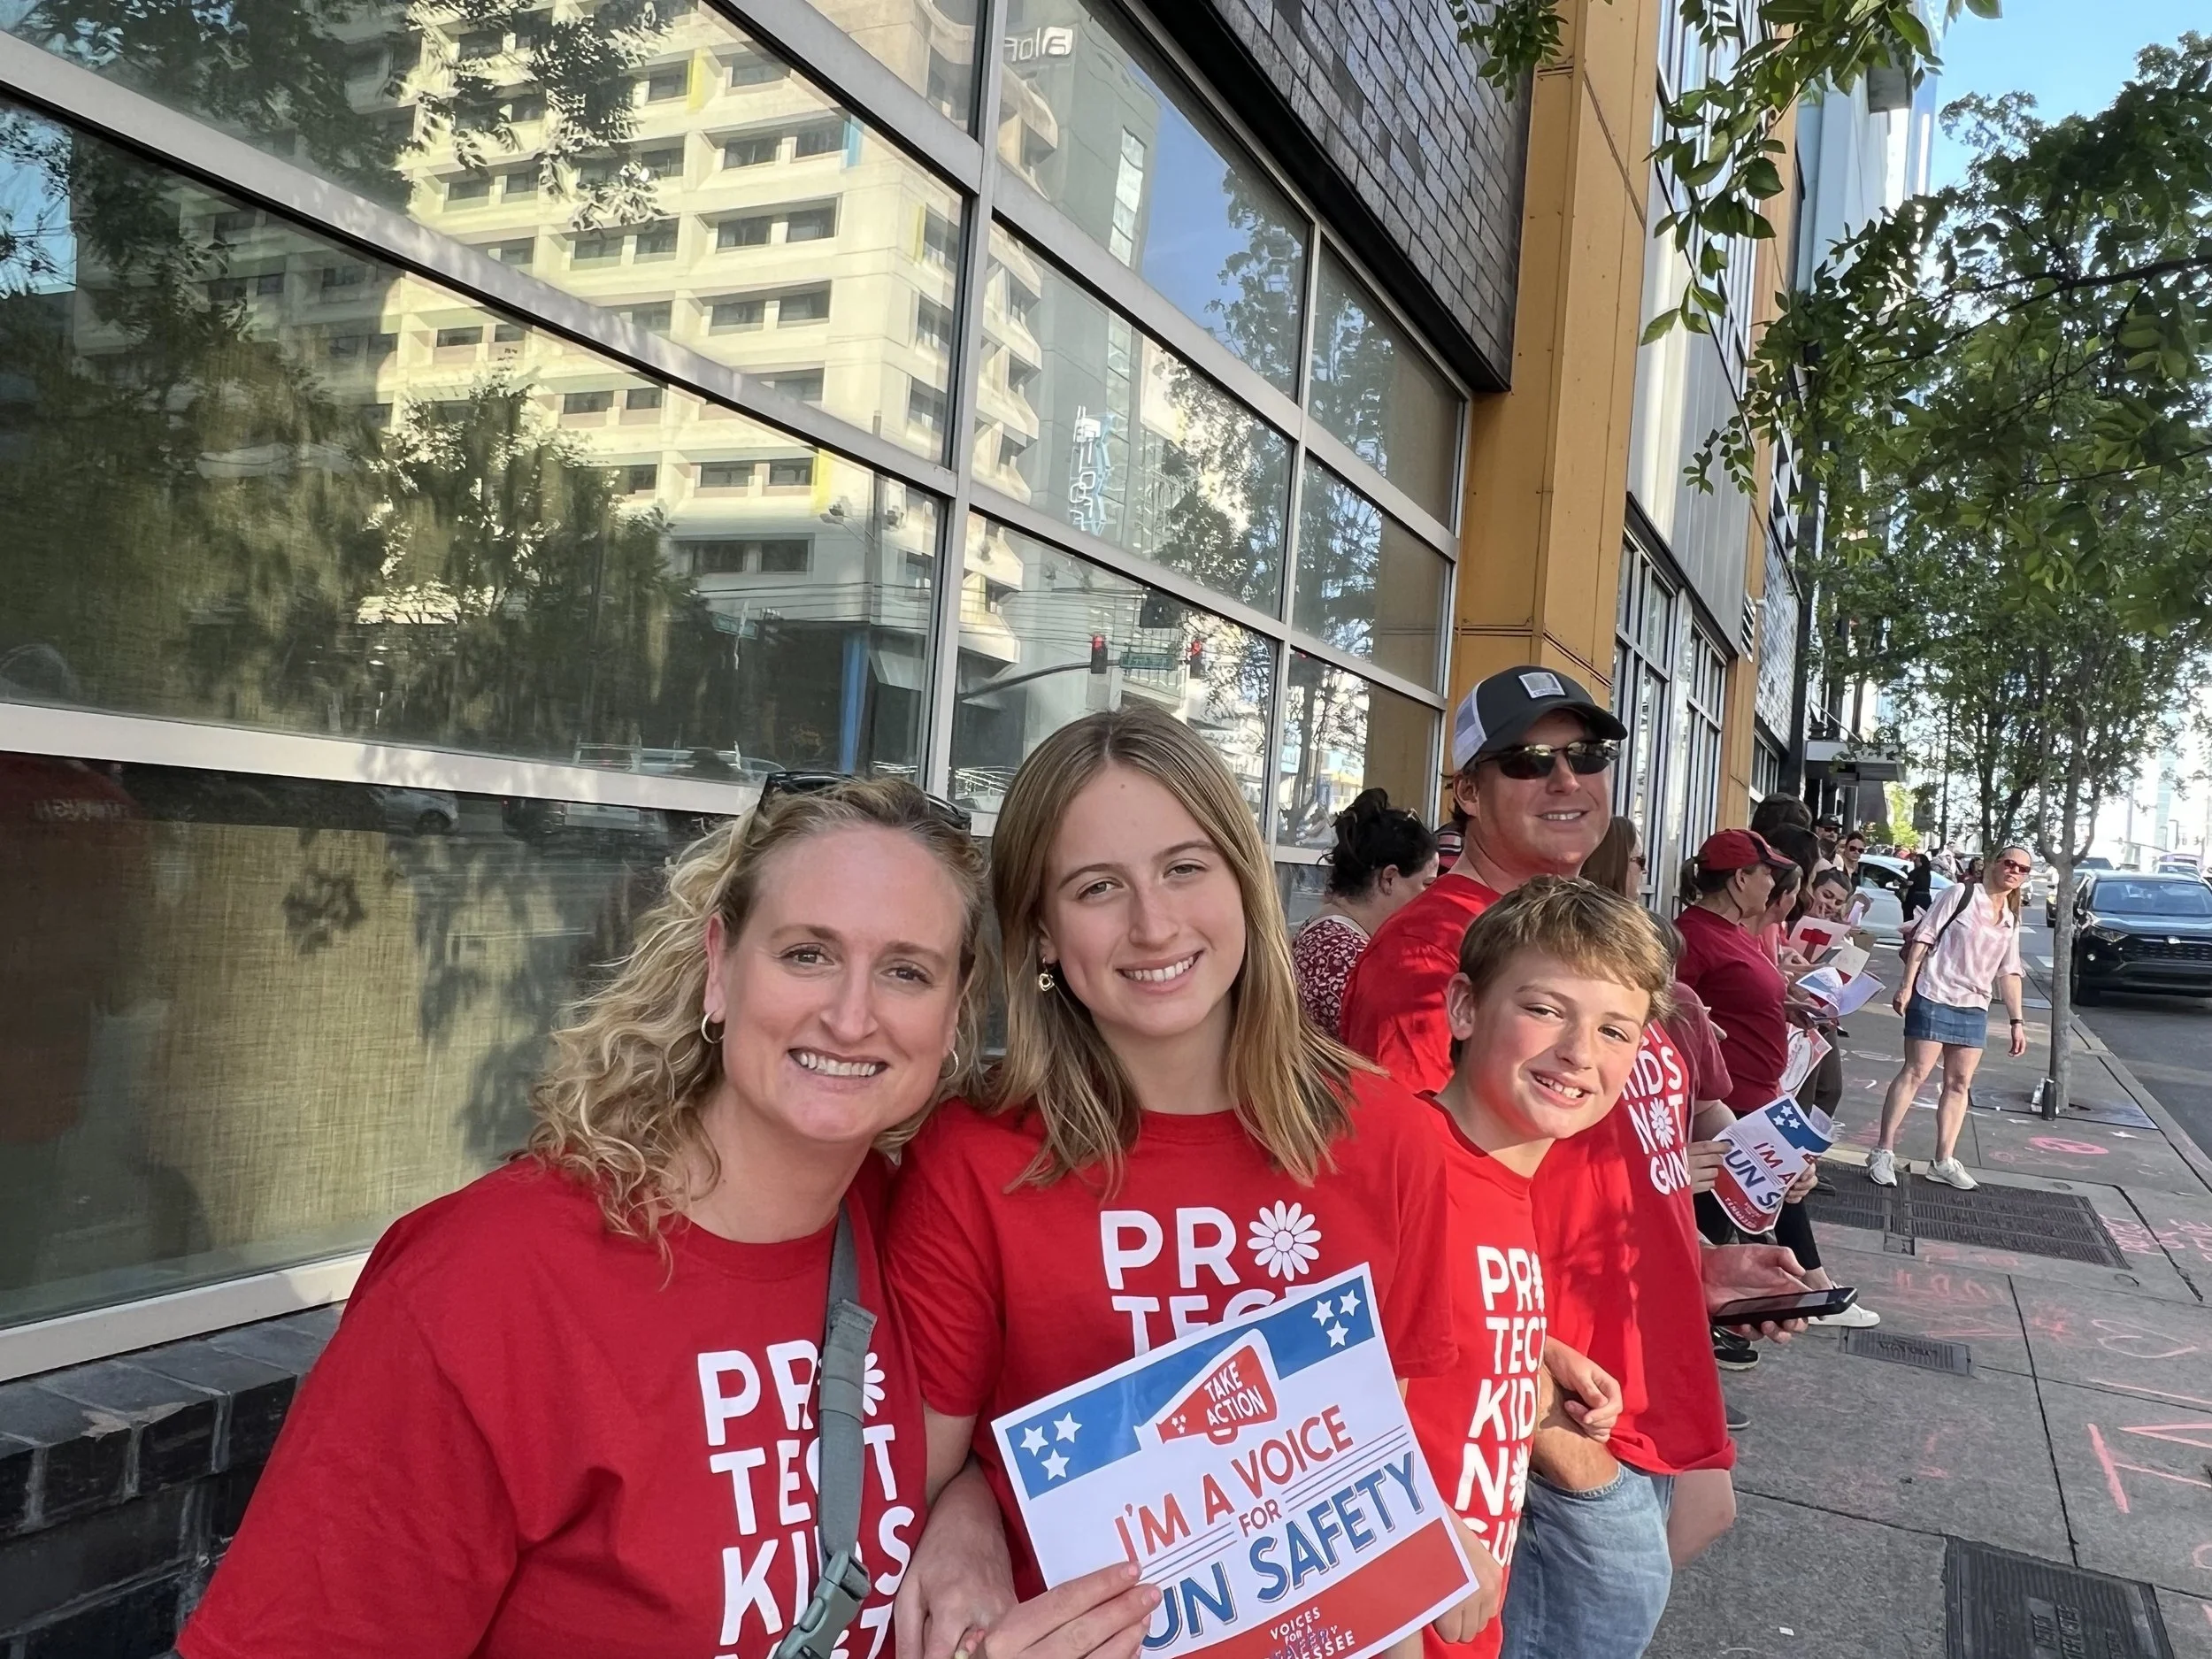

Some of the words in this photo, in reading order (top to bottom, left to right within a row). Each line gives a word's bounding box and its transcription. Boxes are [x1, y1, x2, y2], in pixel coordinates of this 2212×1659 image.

[1753, 1142, 1784, 1169] I'M
[1777, 1172, 1797, 1185] A
[1204, 1361, 1243, 1402] TAKE
[1206, 1385, 1268, 1426] ACTION
[1468, 1377, 1540, 1441] KID
[1114, 1493, 1191, 1565] I'M
[1202, 1473, 1235, 1525] A
[1231, 1404, 1354, 1500] VOICE
[1239, 1498, 1282, 1538] FOR
[1249, 1451, 1425, 1603] SAFETY
[1270, 1606, 1321, 1640] VOICES
[1285, 1629, 1302, 1647] FOR
